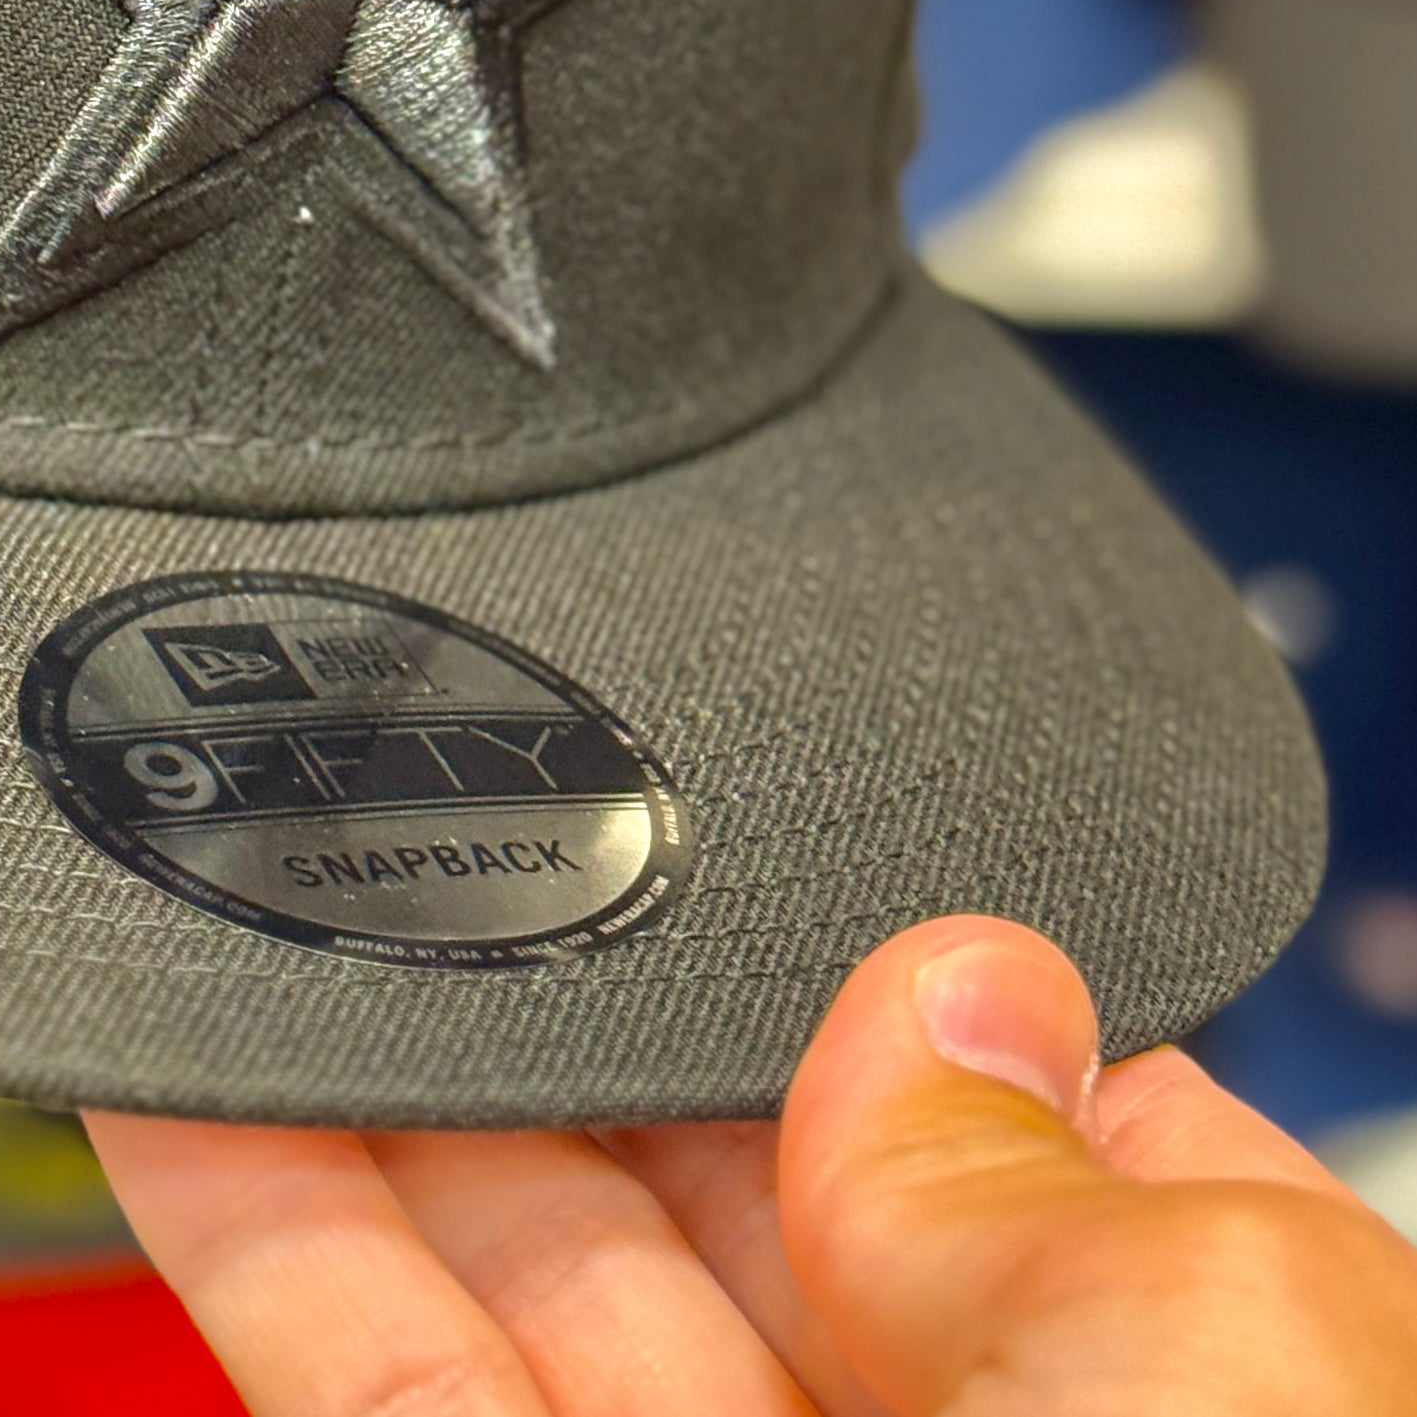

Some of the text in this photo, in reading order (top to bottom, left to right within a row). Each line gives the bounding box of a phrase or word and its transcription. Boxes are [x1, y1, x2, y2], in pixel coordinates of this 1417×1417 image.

[295, 637, 390, 660] NEW
[312, 657, 406, 682] ERA
[122, 725, 560, 812] 9FIFTY
[282, 838, 582, 887] SNAPBACK
